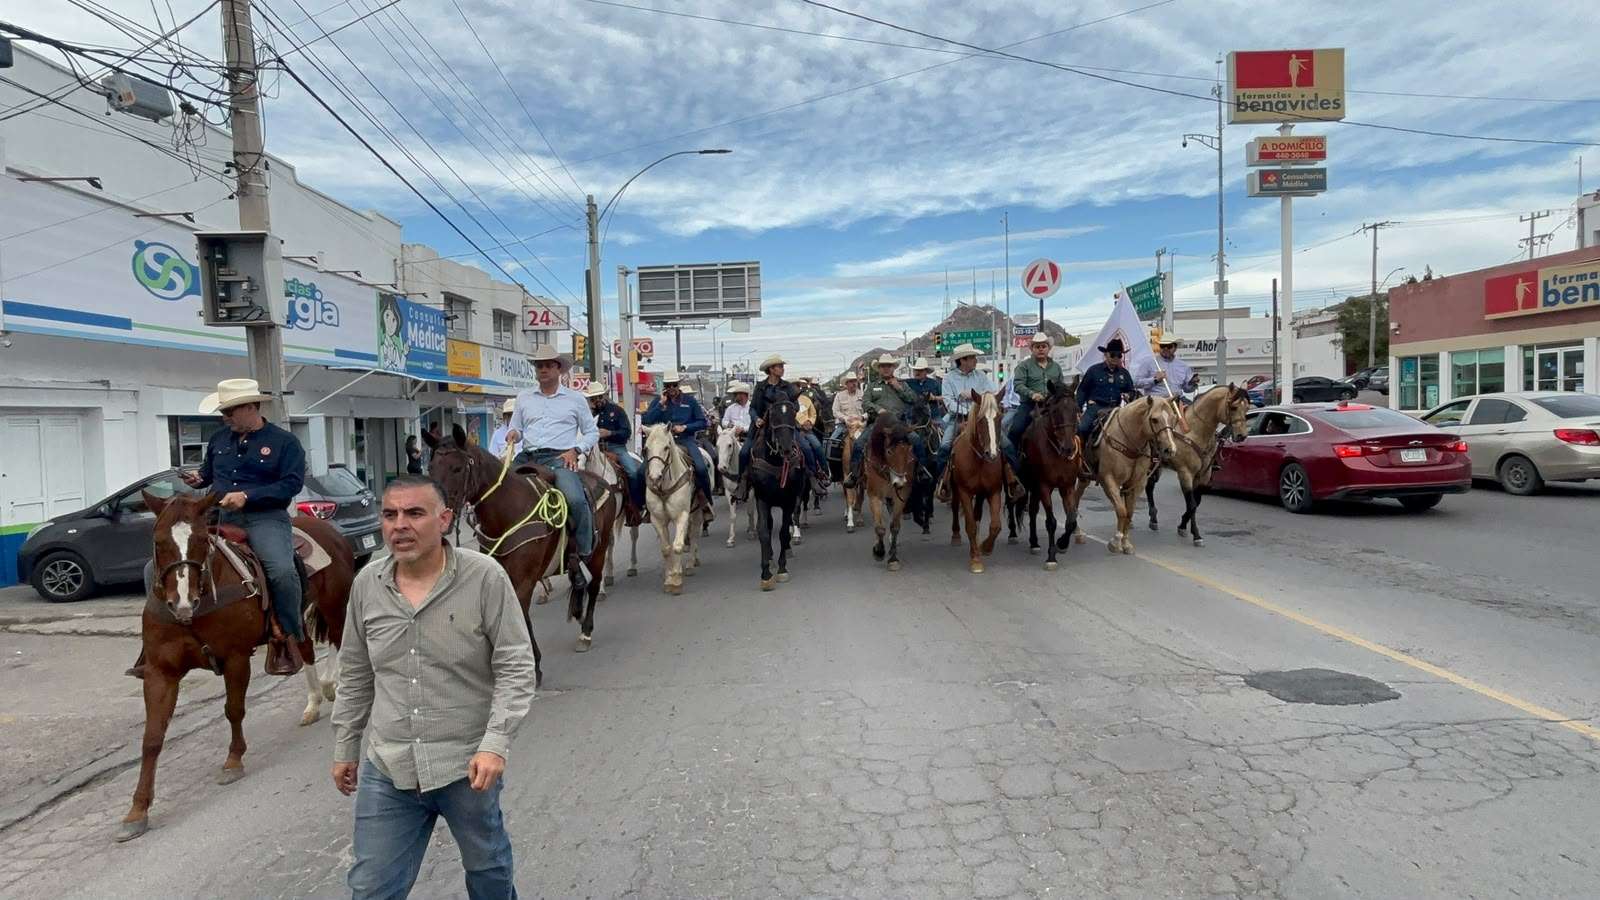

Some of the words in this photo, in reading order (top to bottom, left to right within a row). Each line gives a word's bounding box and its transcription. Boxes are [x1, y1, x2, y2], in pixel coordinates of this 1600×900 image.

[1236, 93, 1341, 112] benavides
[1242, 91, 1292, 100] farmacias
[1271, 142, 1324, 150] DOMICILIO
[1542, 280, 1599, 307] ben
[527, 310, 551, 326] 24
[407, 321, 446, 352] Médica
[1196, 340, 1217, 352] Ahor
[500, 356, 535, 379] FARMACIAS
